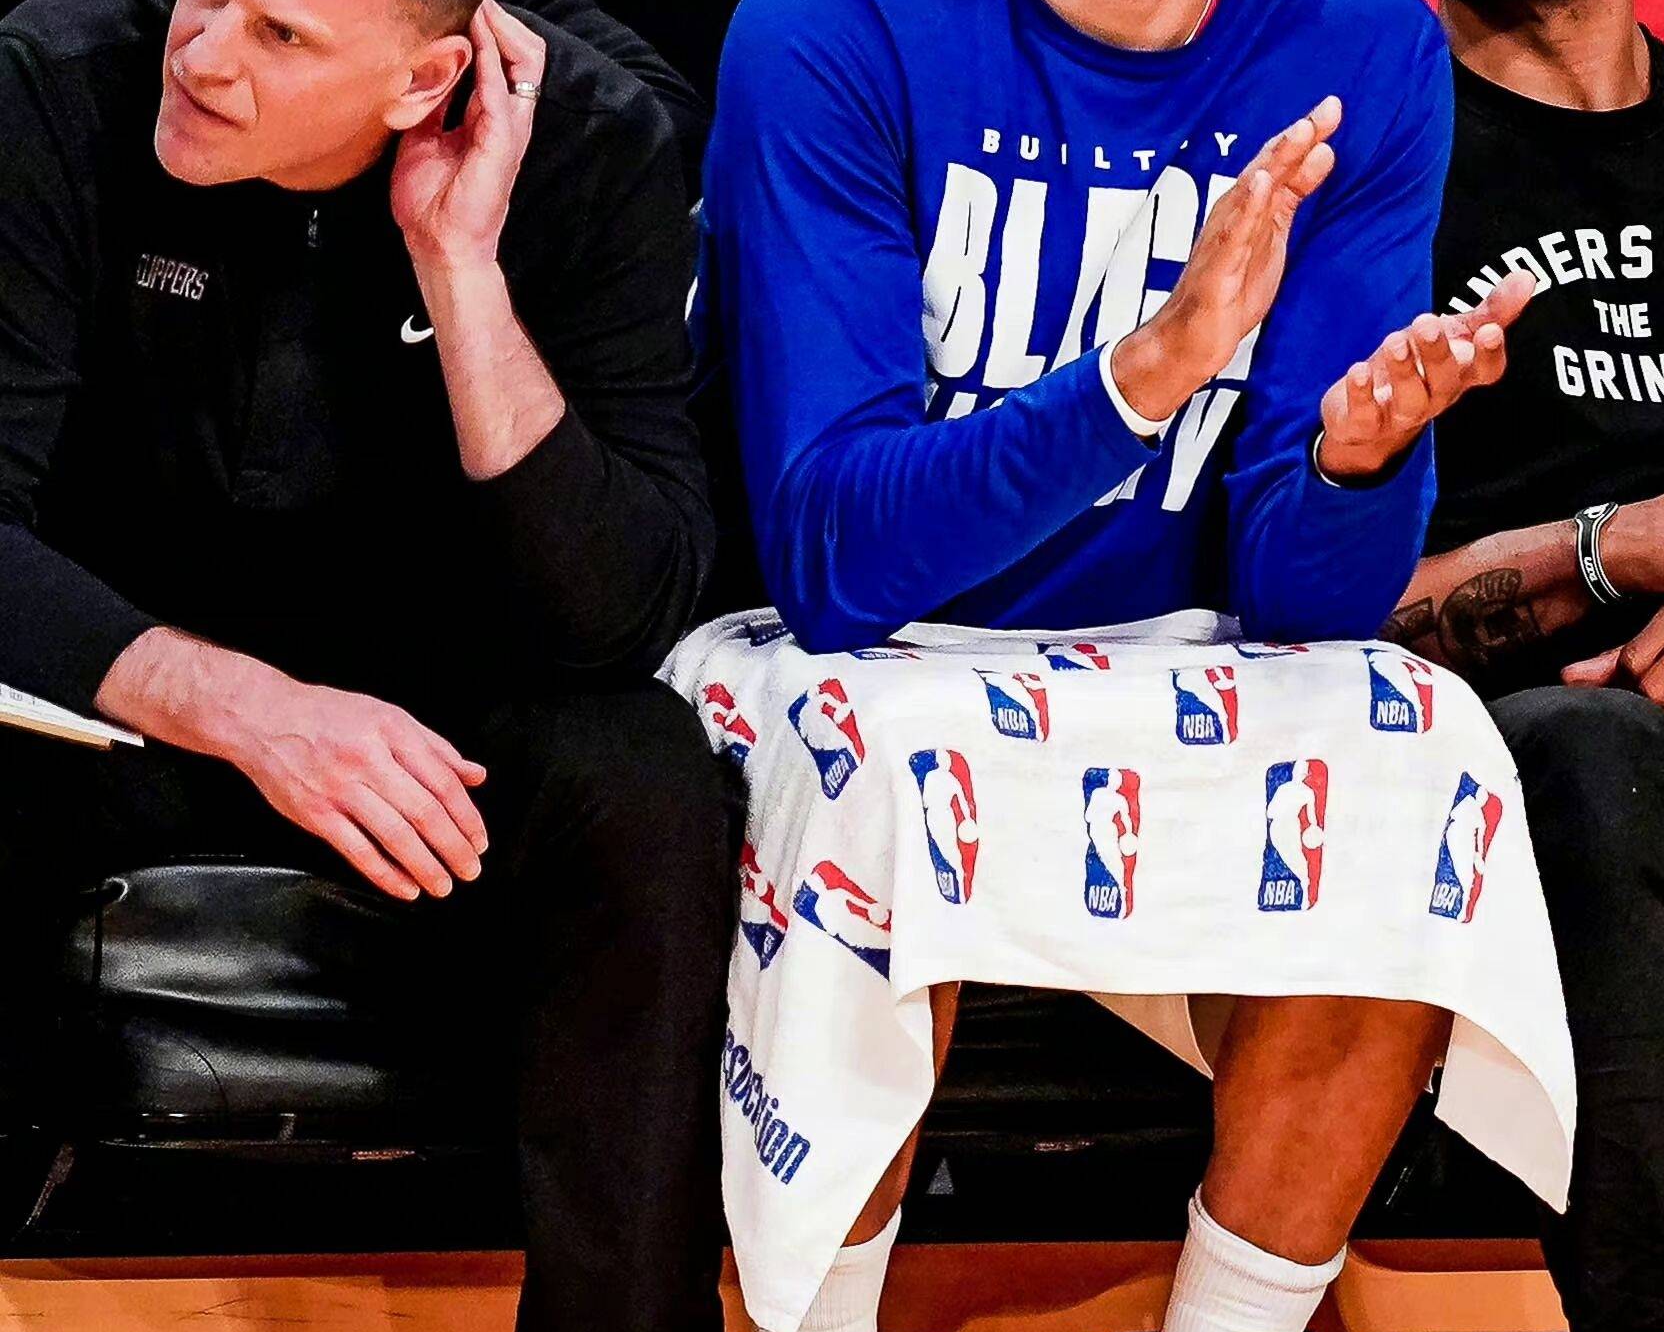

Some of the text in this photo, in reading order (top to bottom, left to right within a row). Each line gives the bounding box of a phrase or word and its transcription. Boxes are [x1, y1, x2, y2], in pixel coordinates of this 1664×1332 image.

[982, 128, 1156, 172] BUILT
[136, 253, 209, 301] CLIPPERS
[1593, 299, 1652, 338] THE
[997, 706, 1029, 733] NBA
[1183, 713, 1215, 740] NBA
[1376, 700, 1411, 727] NBA
[1088, 884, 1120, 914] NBA
[1264, 879, 1296, 907] NBA
